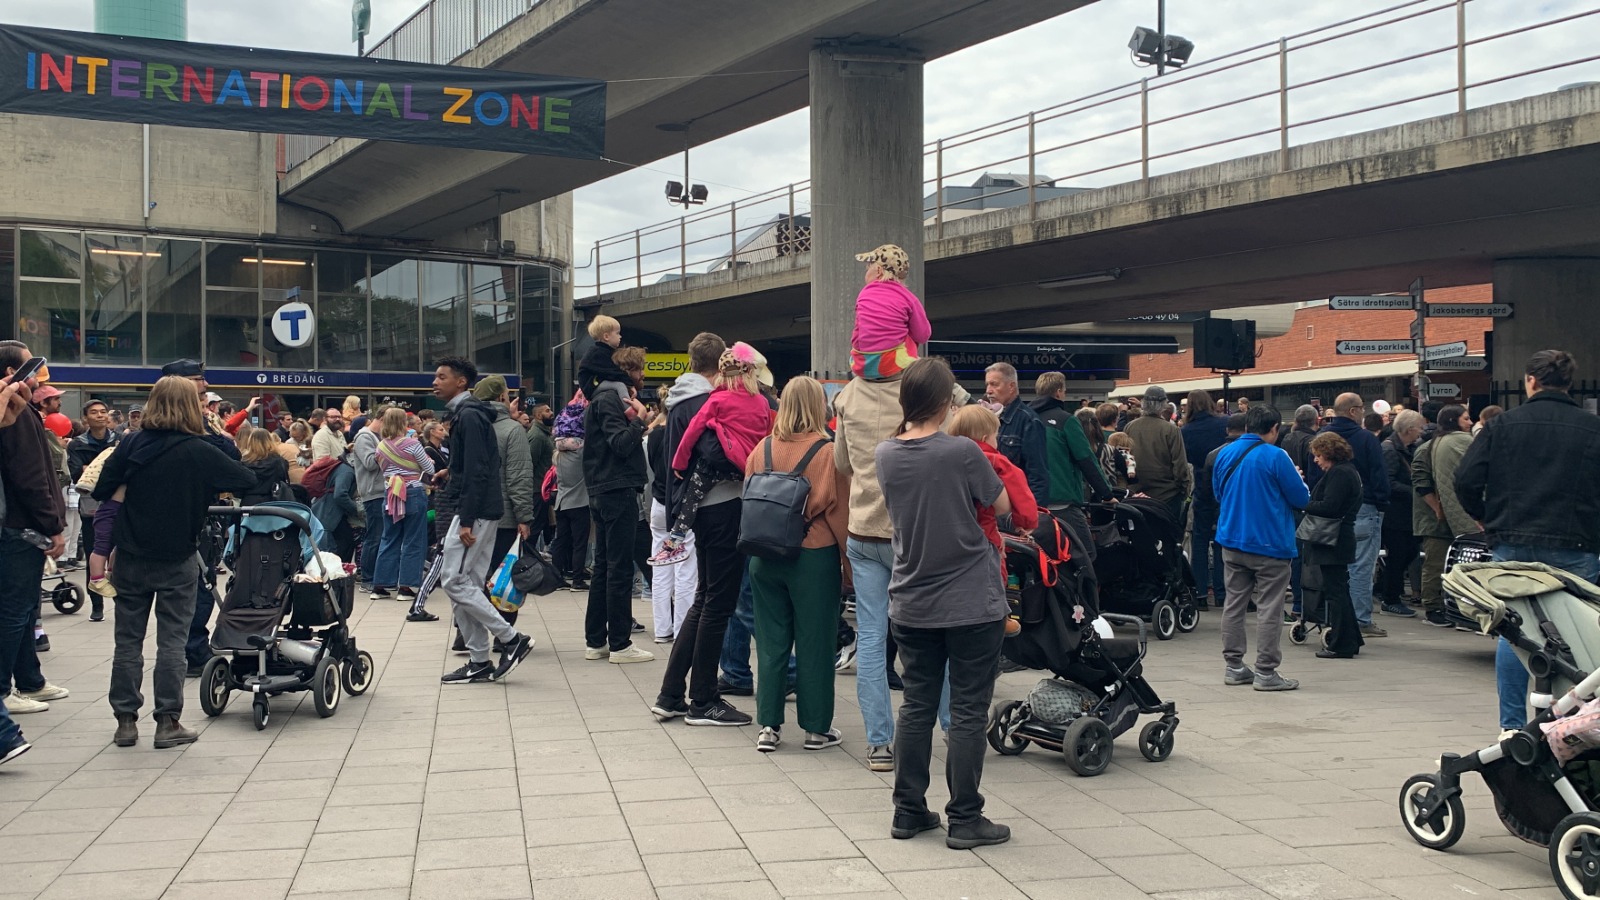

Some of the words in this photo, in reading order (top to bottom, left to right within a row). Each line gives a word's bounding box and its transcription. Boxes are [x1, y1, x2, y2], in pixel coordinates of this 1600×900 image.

[26, 52, 428, 120] INTERNATIONAL
[442, 87, 572, 133] ZONE
[1337, 299, 1360, 307] Sätra
[1362, 299, 1409, 308] idrottsplats
[1432, 306, 1485, 315] Jakobsbergs
[1487, 306, 1507, 315] gård
[280, 310, 306, 340] T
[1344, 342, 1376, 352] Ängens
[1378, 343, 1410, 352] parklek
[944, 352, 993, 365] EDÄNGS
[996, 354, 1019, 364] BAR
[1023, 354, 1030, 364] &
[643, 357, 691, 375] ressby
[1432, 386, 1453, 395] Lyran
